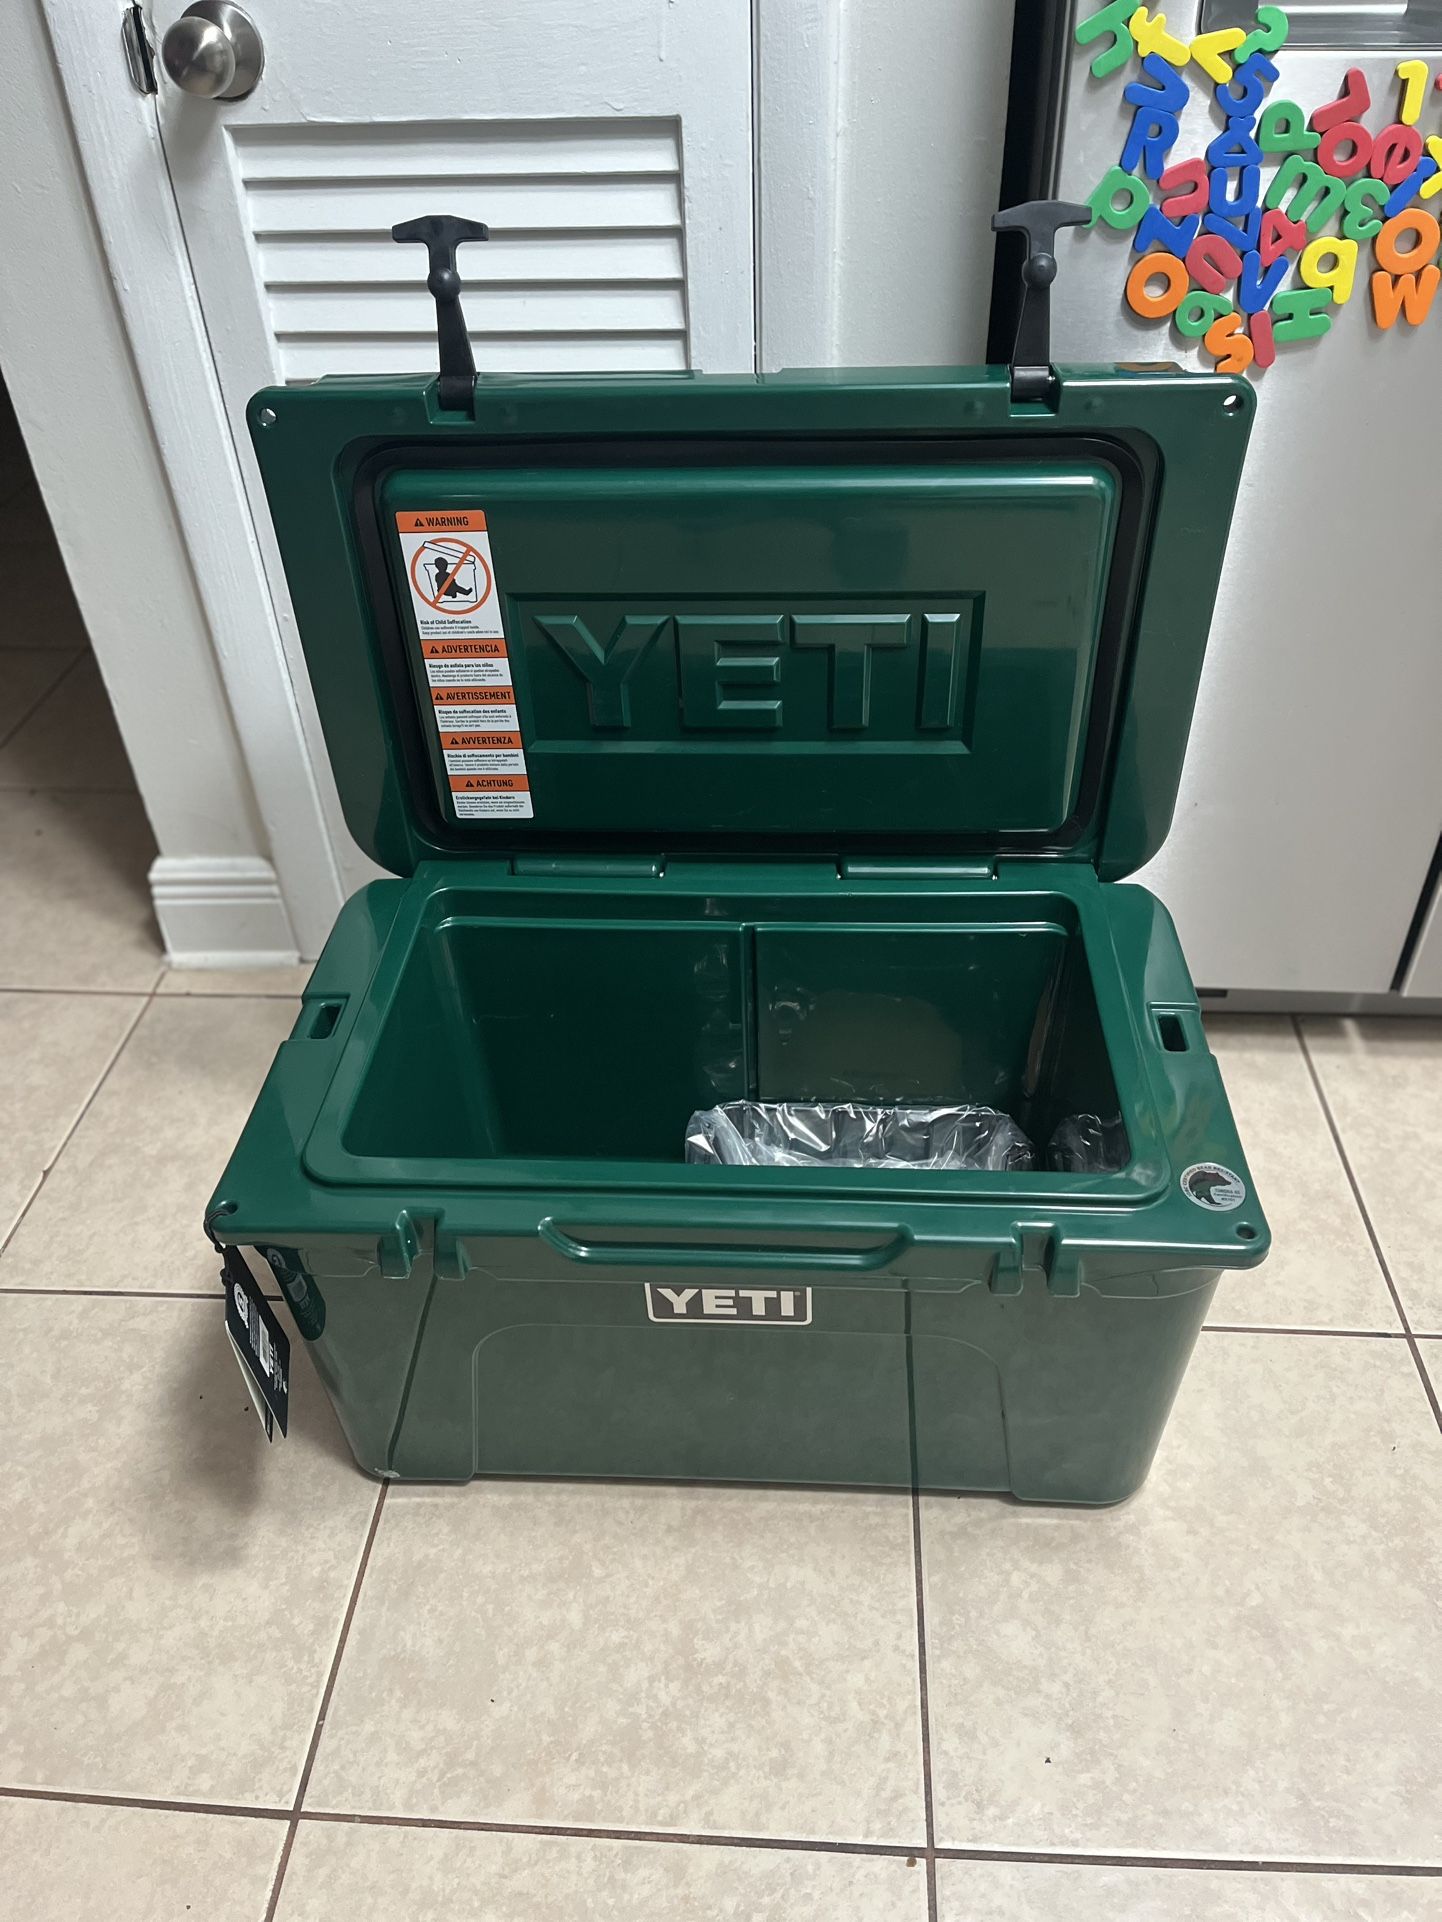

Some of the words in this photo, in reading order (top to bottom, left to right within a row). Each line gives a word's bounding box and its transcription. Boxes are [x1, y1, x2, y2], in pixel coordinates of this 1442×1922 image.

[1121, 106, 1180, 180] R
[1372, 264, 1441, 330] W
[1272, 288, 1332, 342] H
[426, 516, 468, 527] WARNING
[442, 644, 500, 653] ADVERTENCIA
[532, 613, 961, 730] YETI
[446, 691, 511, 700] AVERTISSEMENT
[461, 737, 513, 745] AVVERTENZA
[656, 1288, 794, 1316] YETI
